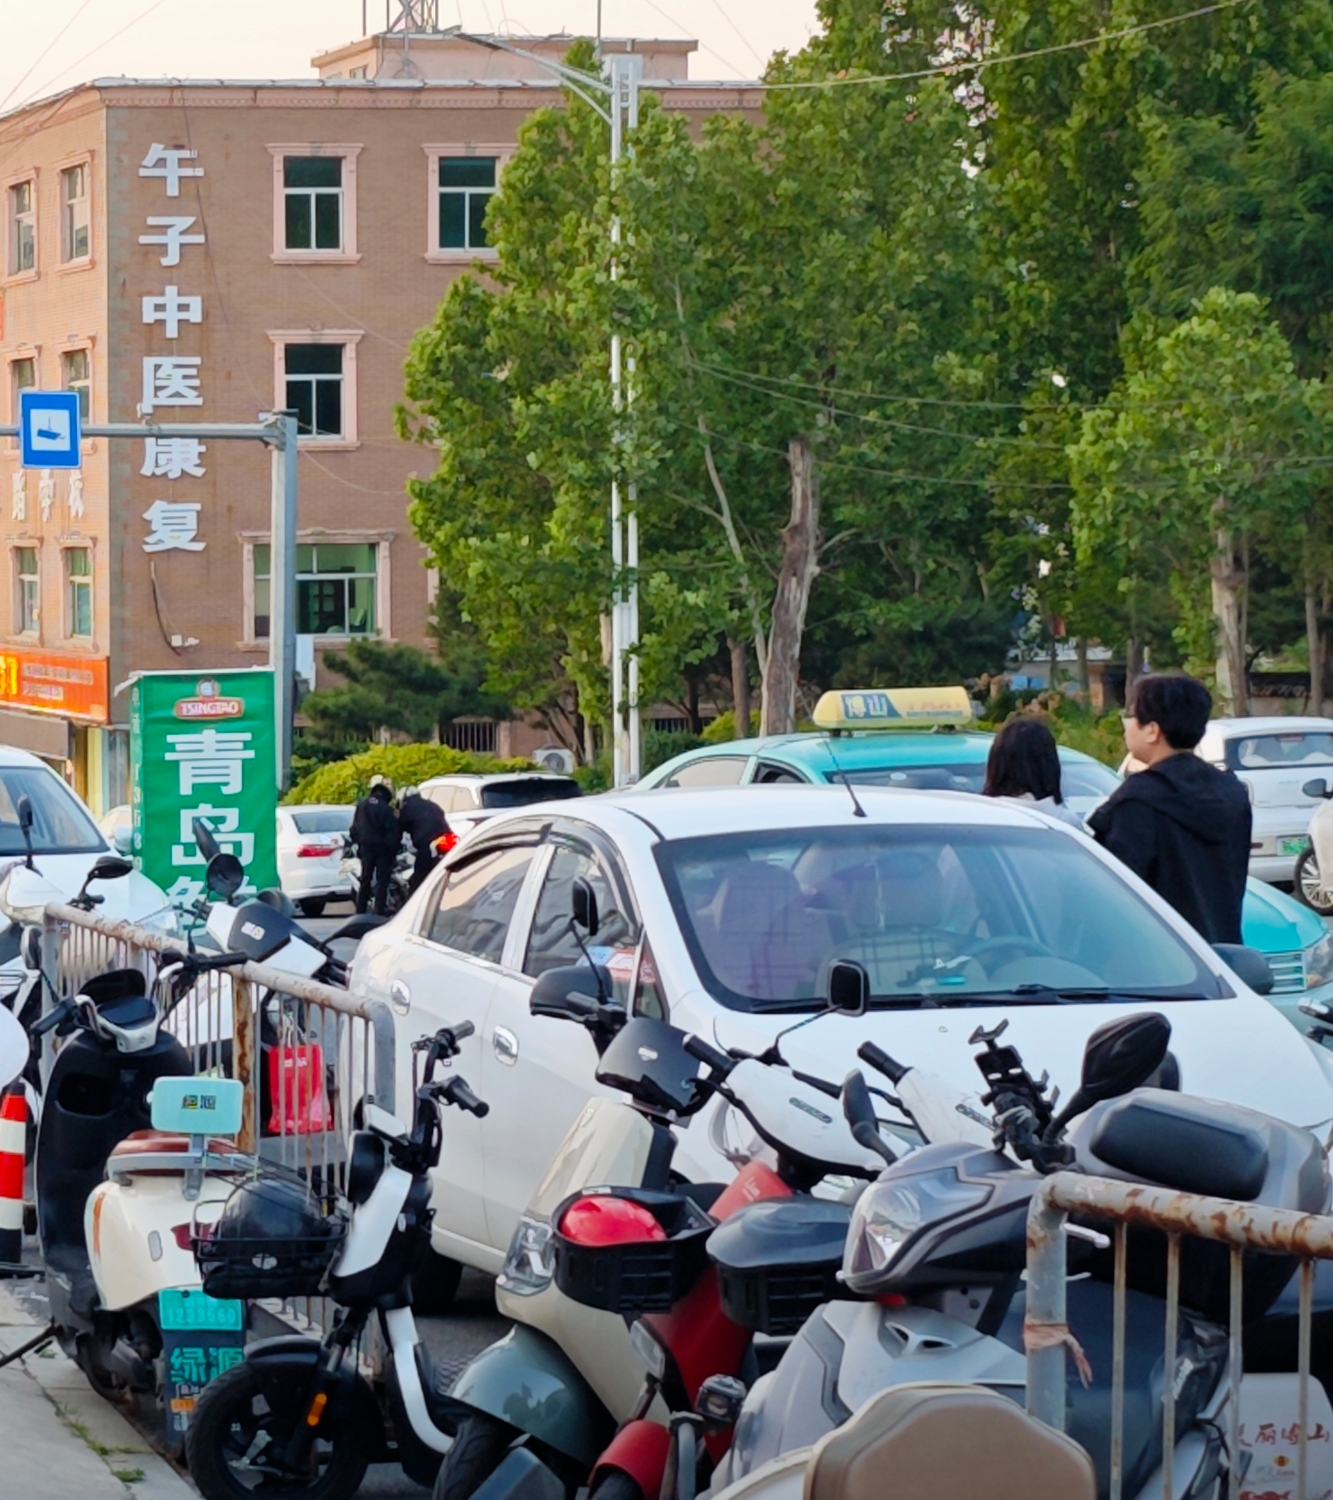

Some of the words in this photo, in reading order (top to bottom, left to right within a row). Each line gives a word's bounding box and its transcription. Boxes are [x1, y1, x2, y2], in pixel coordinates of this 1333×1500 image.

[139, 143, 207, 553] 午子中医康复
[180, 701, 239, 716] TSINGTAO
[164, 728, 256, 914] 青岛
